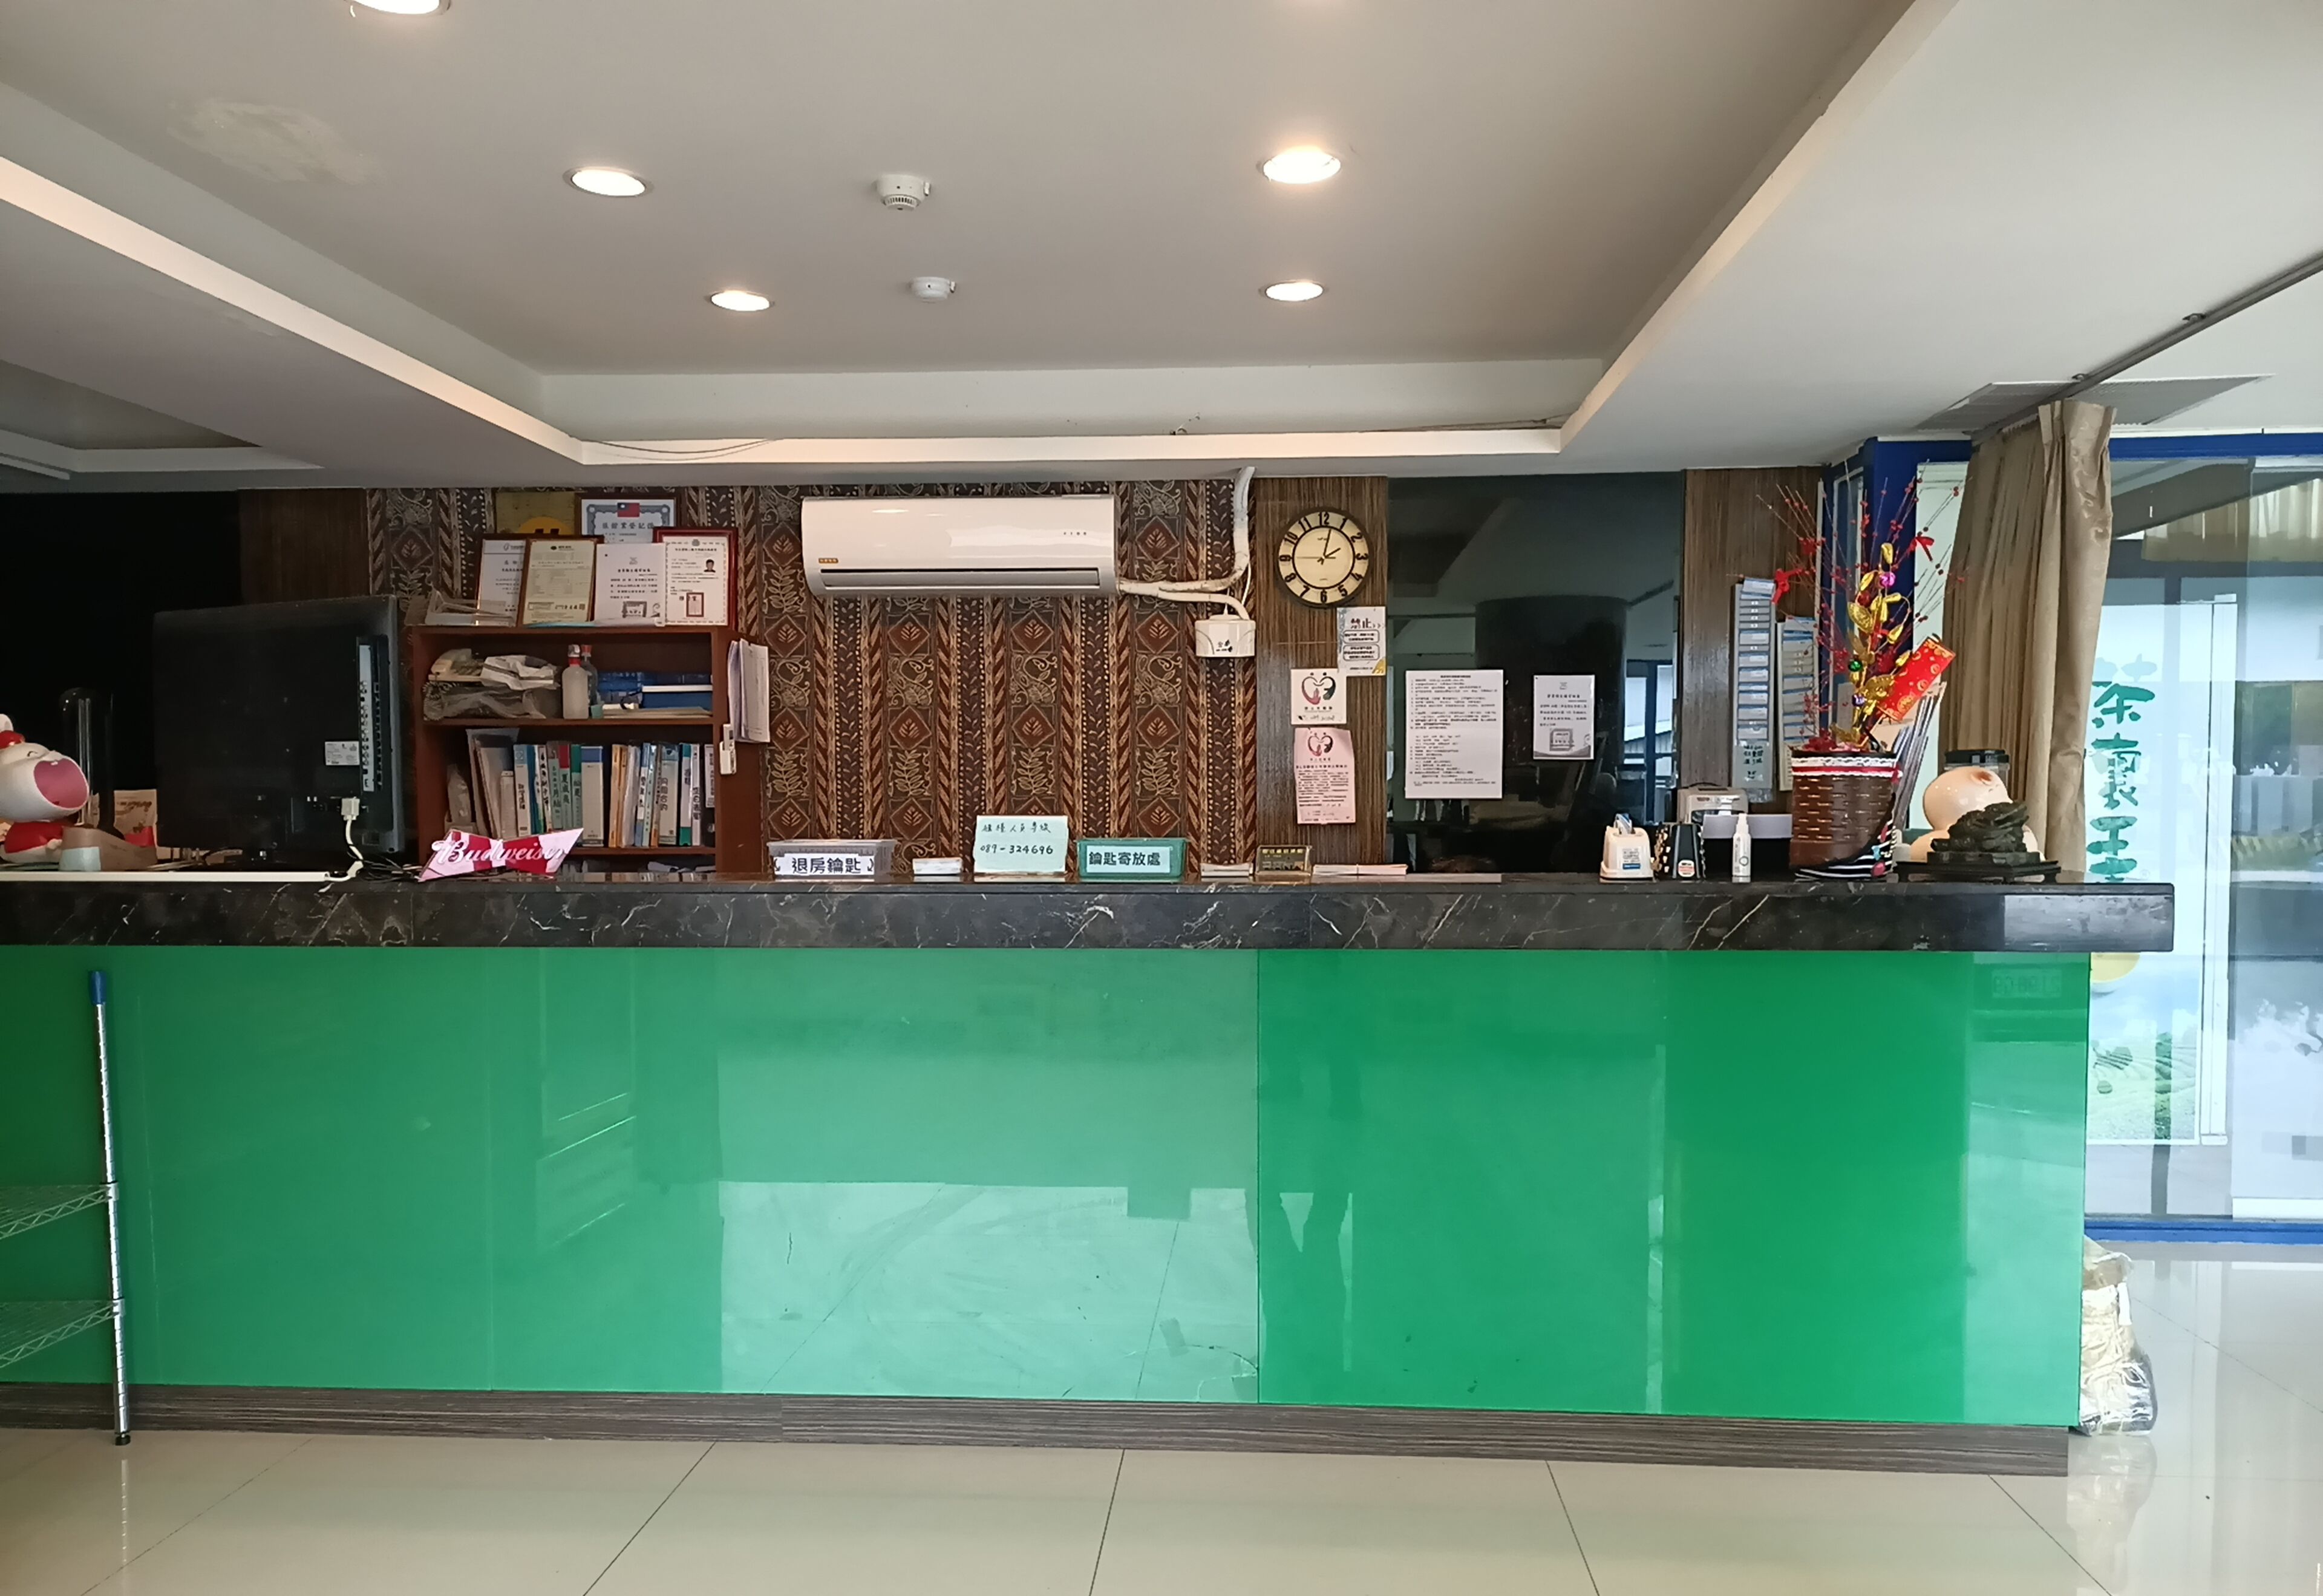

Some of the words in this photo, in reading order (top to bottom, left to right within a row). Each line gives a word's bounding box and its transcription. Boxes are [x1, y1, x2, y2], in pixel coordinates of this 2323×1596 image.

[1298, 517, 1312, 532] 11
[1318, 512, 1330, 525] 12
[1339, 517, 1348, 531] 1
[1284, 531, 1298, 545] 10
[1350, 532, 1363, 543] 2
[1284, 572, 1296, 583] 8
[1351, 572, 1364, 581] 4
[1300, 584, 1310, 597] 7
[1320, 590, 1327, 603] 6
[1338, 584, 1348, 597] 5
[431, 839, 566, 865] Budweiser
[1088, 851, 1161, 866] 鑰匙寄放處
[791, 857, 862, 874] 退房鑰匙
